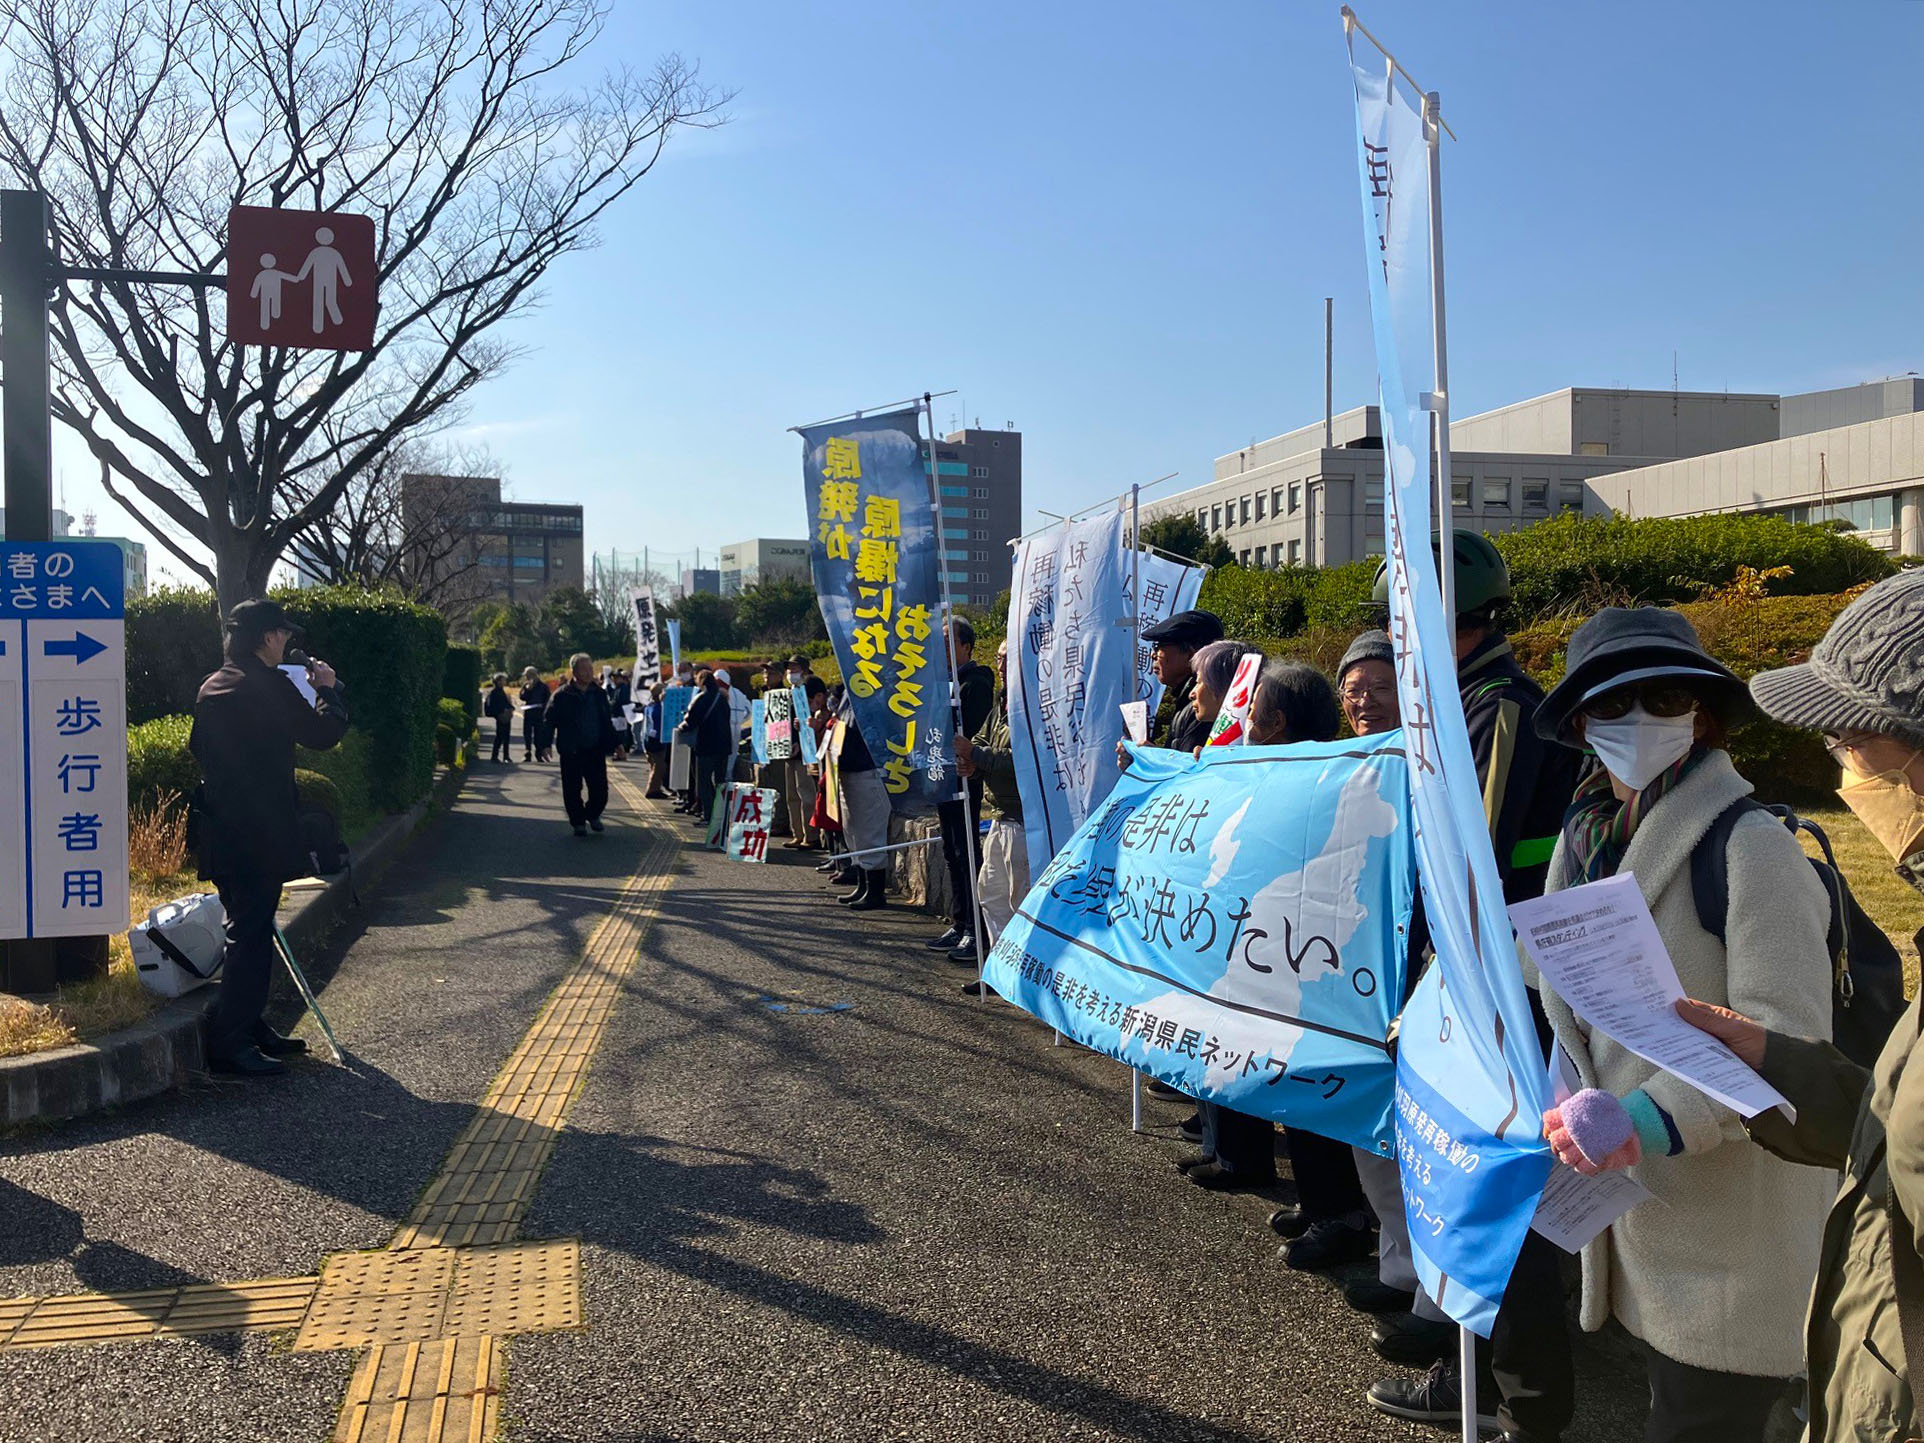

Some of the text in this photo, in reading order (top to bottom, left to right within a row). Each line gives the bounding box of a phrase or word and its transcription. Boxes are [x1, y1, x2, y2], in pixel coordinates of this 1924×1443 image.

[0, 552, 74, 578] 者の
[0, 583, 111, 609] さまへ
[56, 697, 103, 908] 歩行者用
[735, 788, 768, 861] 成功
[1397, 1128, 1432, 1186] を考える
